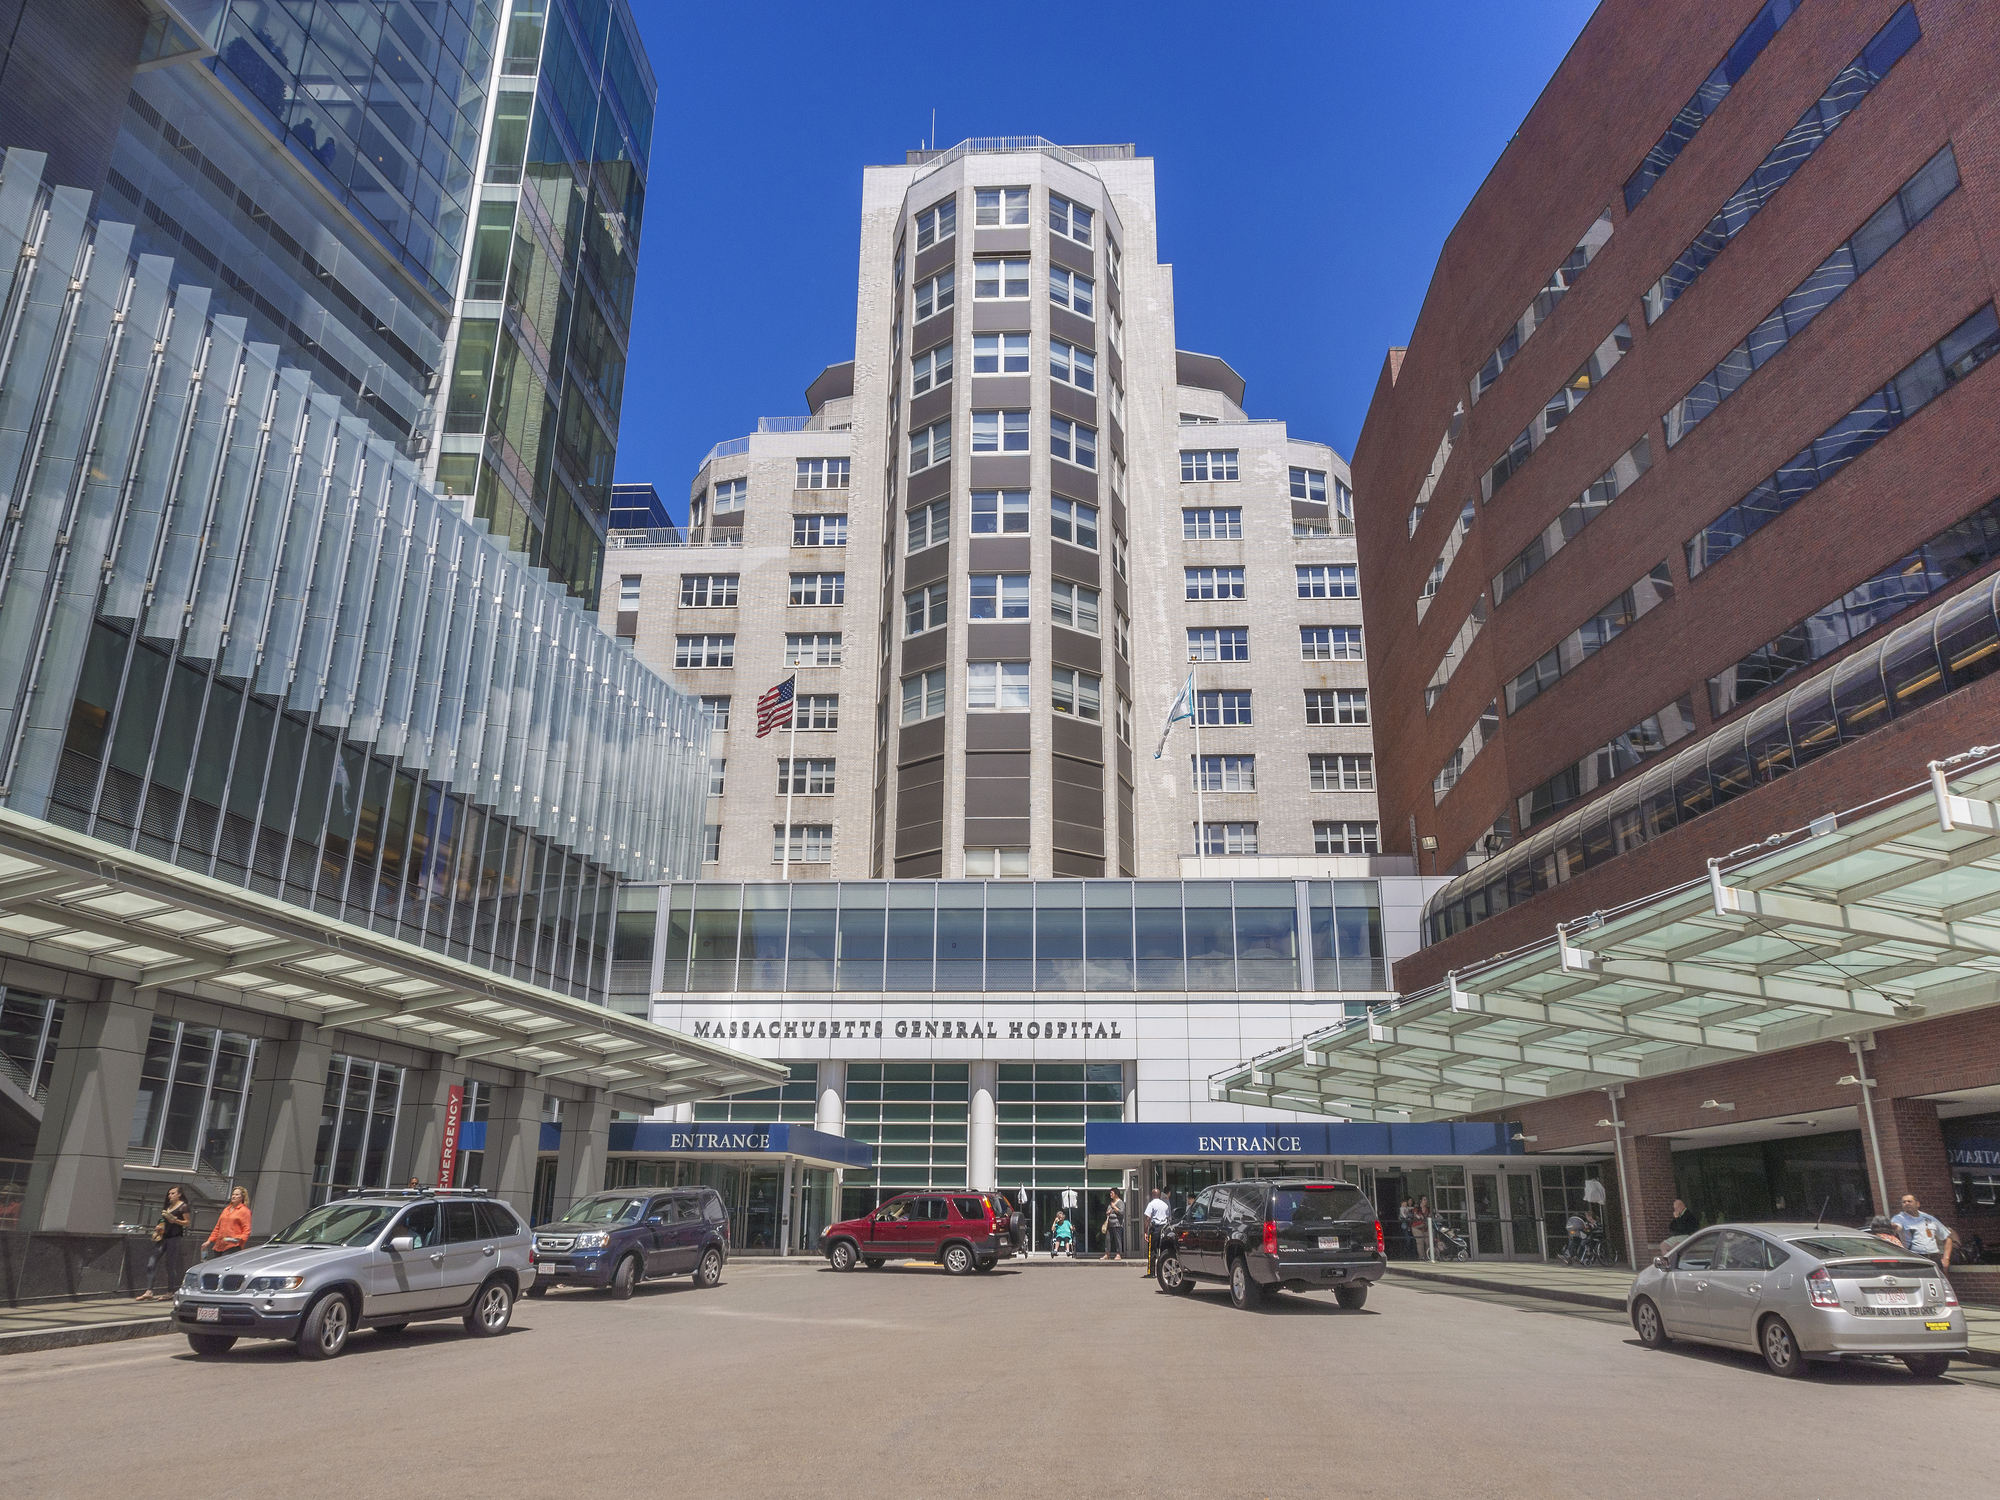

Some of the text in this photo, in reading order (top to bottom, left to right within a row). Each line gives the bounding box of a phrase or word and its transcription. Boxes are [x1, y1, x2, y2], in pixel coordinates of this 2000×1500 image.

[694, 1020, 1122, 1039] MASSACHUSETTS GENERAL HOSPITAL
[440, 1094, 459, 1193] EMERGENCY
[670, 1133, 770, 1148] ENTRANCE
[1198, 1136, 1302, 1151] ENTRANCE
[1929, 1283, 1937, 1297] 5
